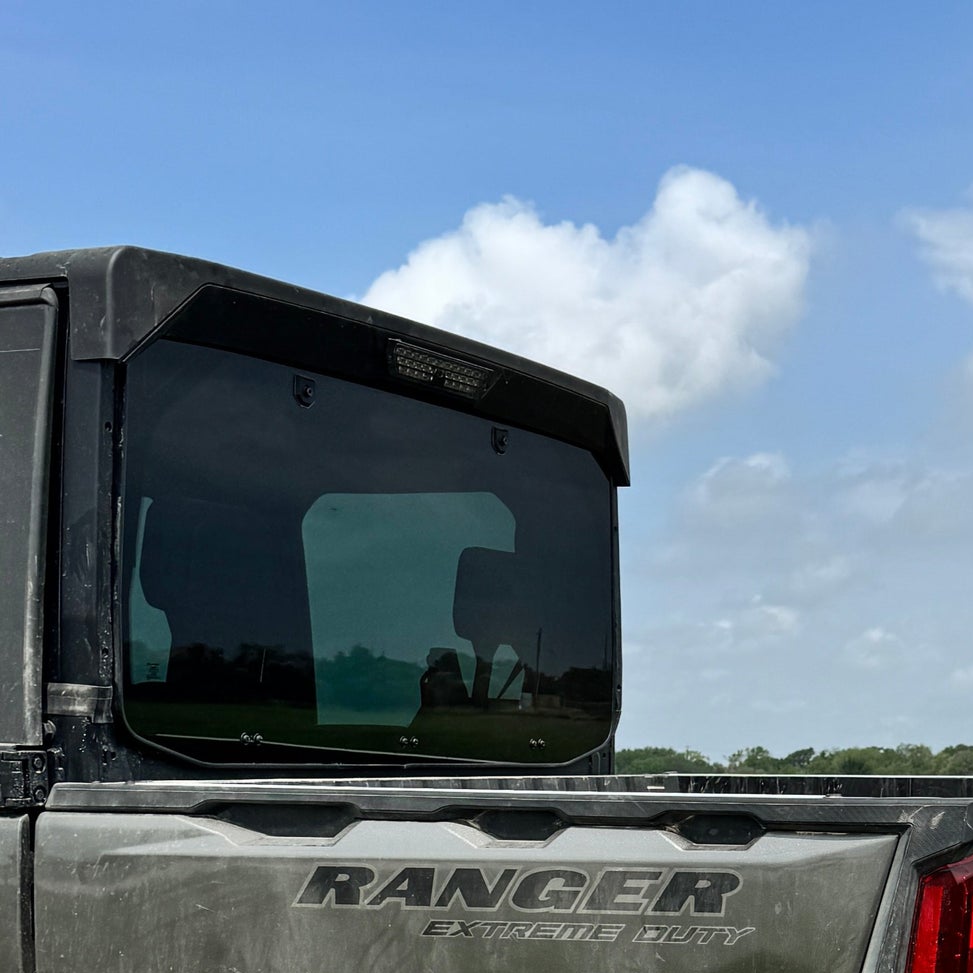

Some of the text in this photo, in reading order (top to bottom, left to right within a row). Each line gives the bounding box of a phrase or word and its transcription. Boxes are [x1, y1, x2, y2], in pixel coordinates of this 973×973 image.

[292, 864, 744, 917] RANGER
[420, 920, 755, 946] EXTREME DUTY
